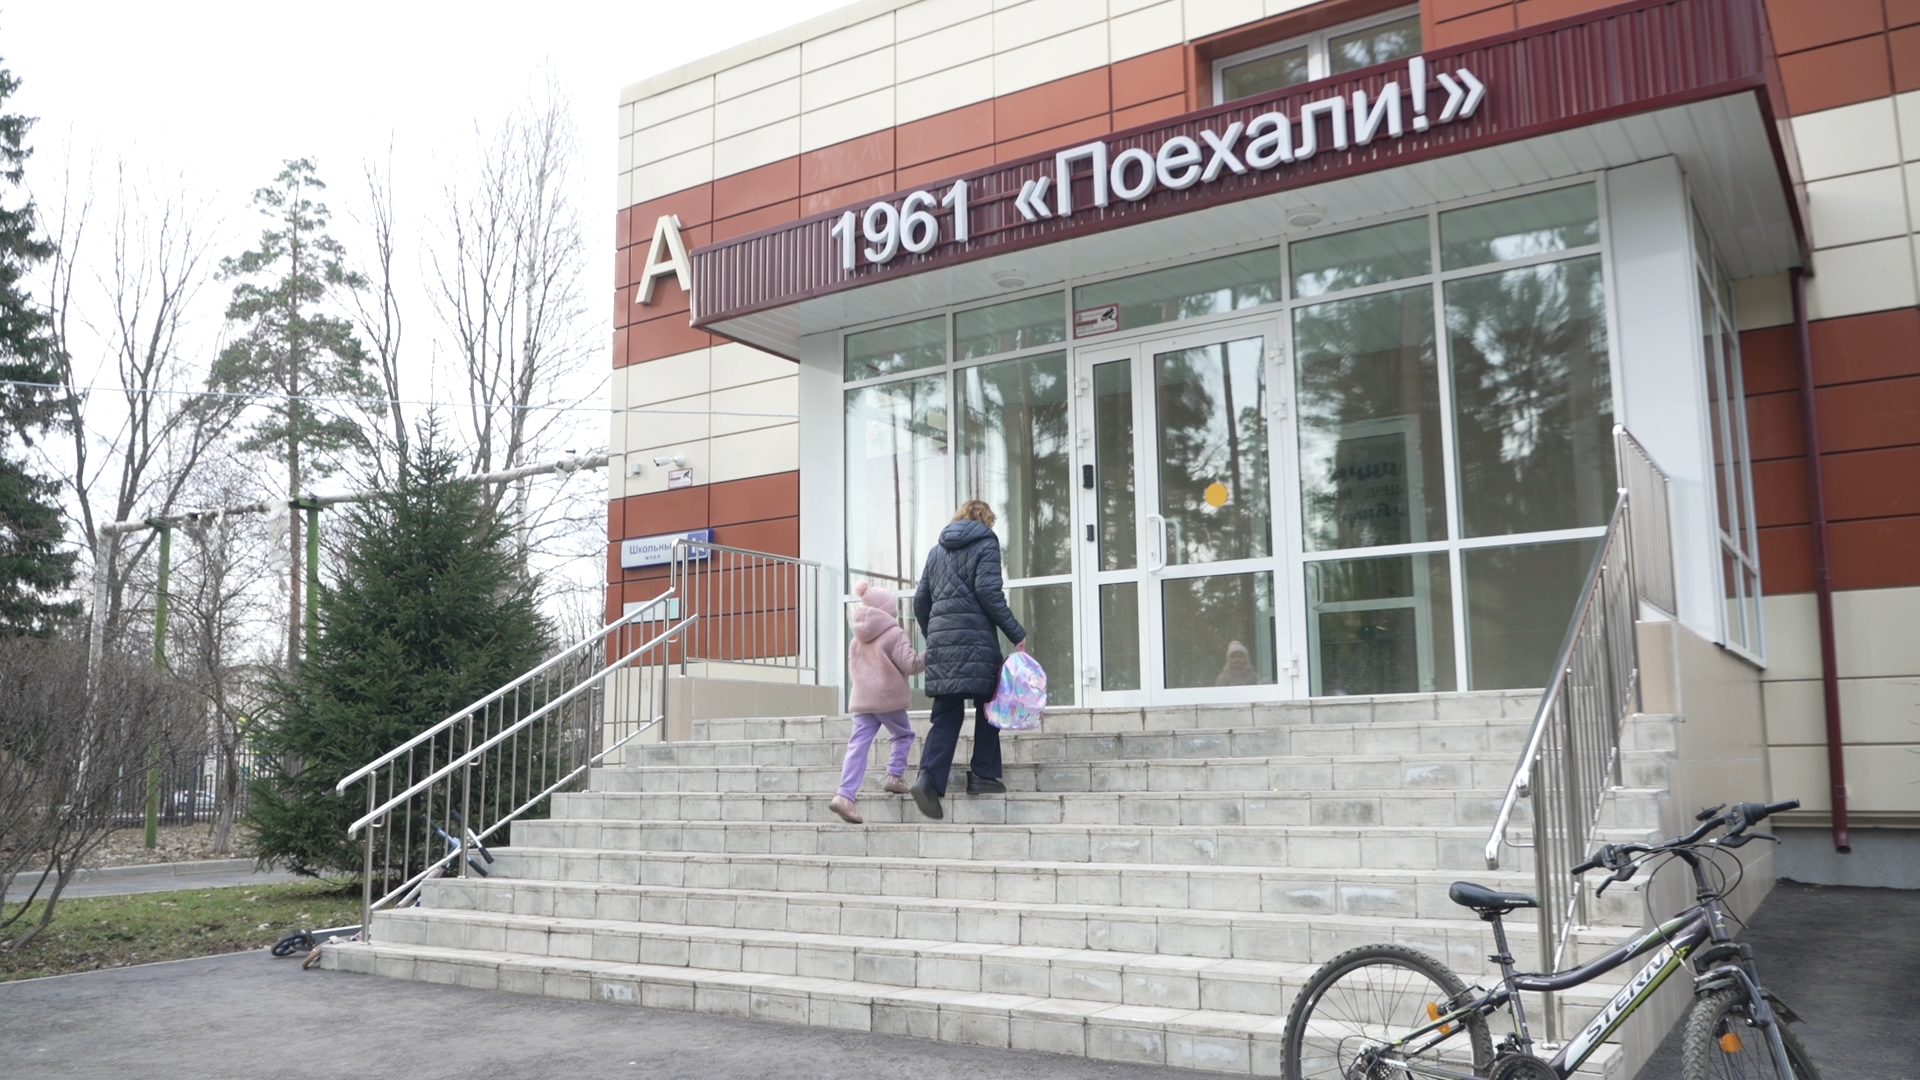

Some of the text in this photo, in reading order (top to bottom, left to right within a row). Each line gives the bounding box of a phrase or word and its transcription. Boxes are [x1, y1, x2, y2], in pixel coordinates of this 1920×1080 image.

[831, 56, 1486, 271] 1961 «Поехали!»
[629, 542, 672, 555] Школьны
[1585, 949, 1667, 1044] STERN
